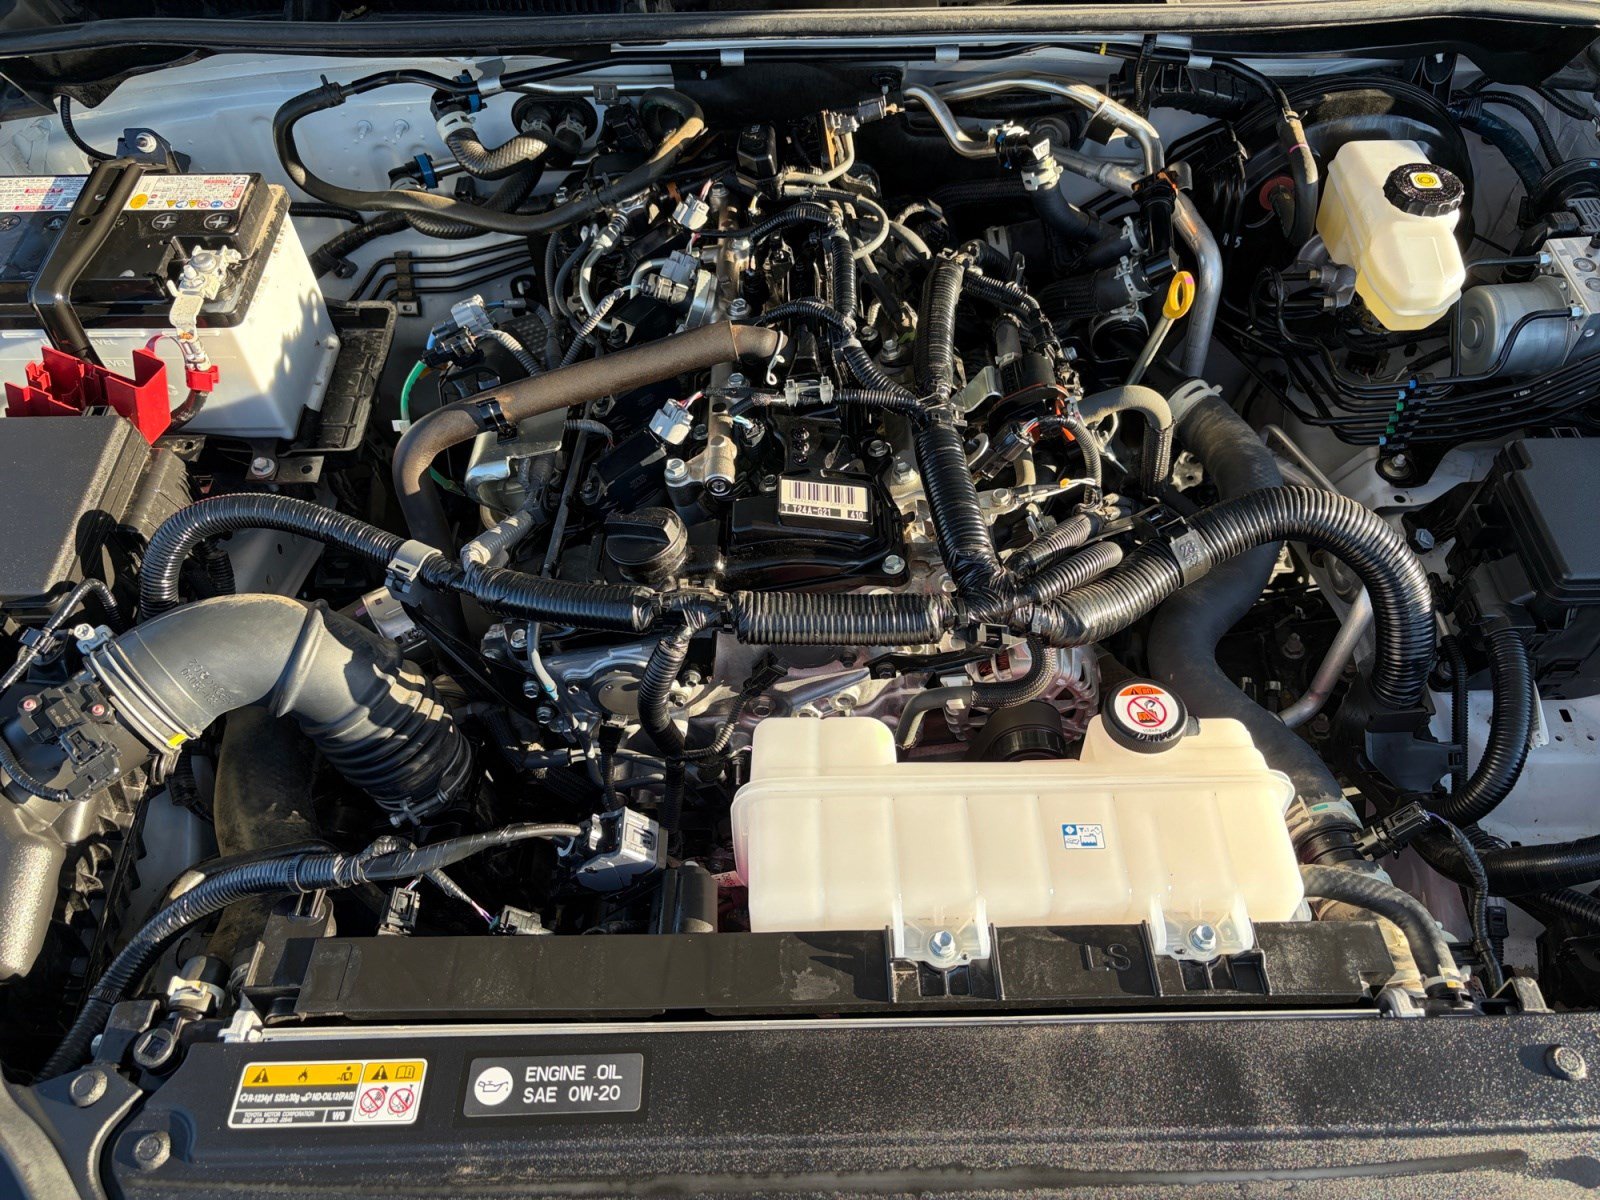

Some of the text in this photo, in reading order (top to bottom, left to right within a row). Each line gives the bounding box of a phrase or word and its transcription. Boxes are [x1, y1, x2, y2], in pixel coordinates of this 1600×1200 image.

[783, 503, 789, 512] T
[792, 504, 831, 517] T24A-G21
[850, 511, 864, 520] 410
[525, 1064, 623, 1082] ENGINE OIL
[523, 1085, 621, 1104] SAE 0W-20
[332, 1111, 346, 1121] W9
